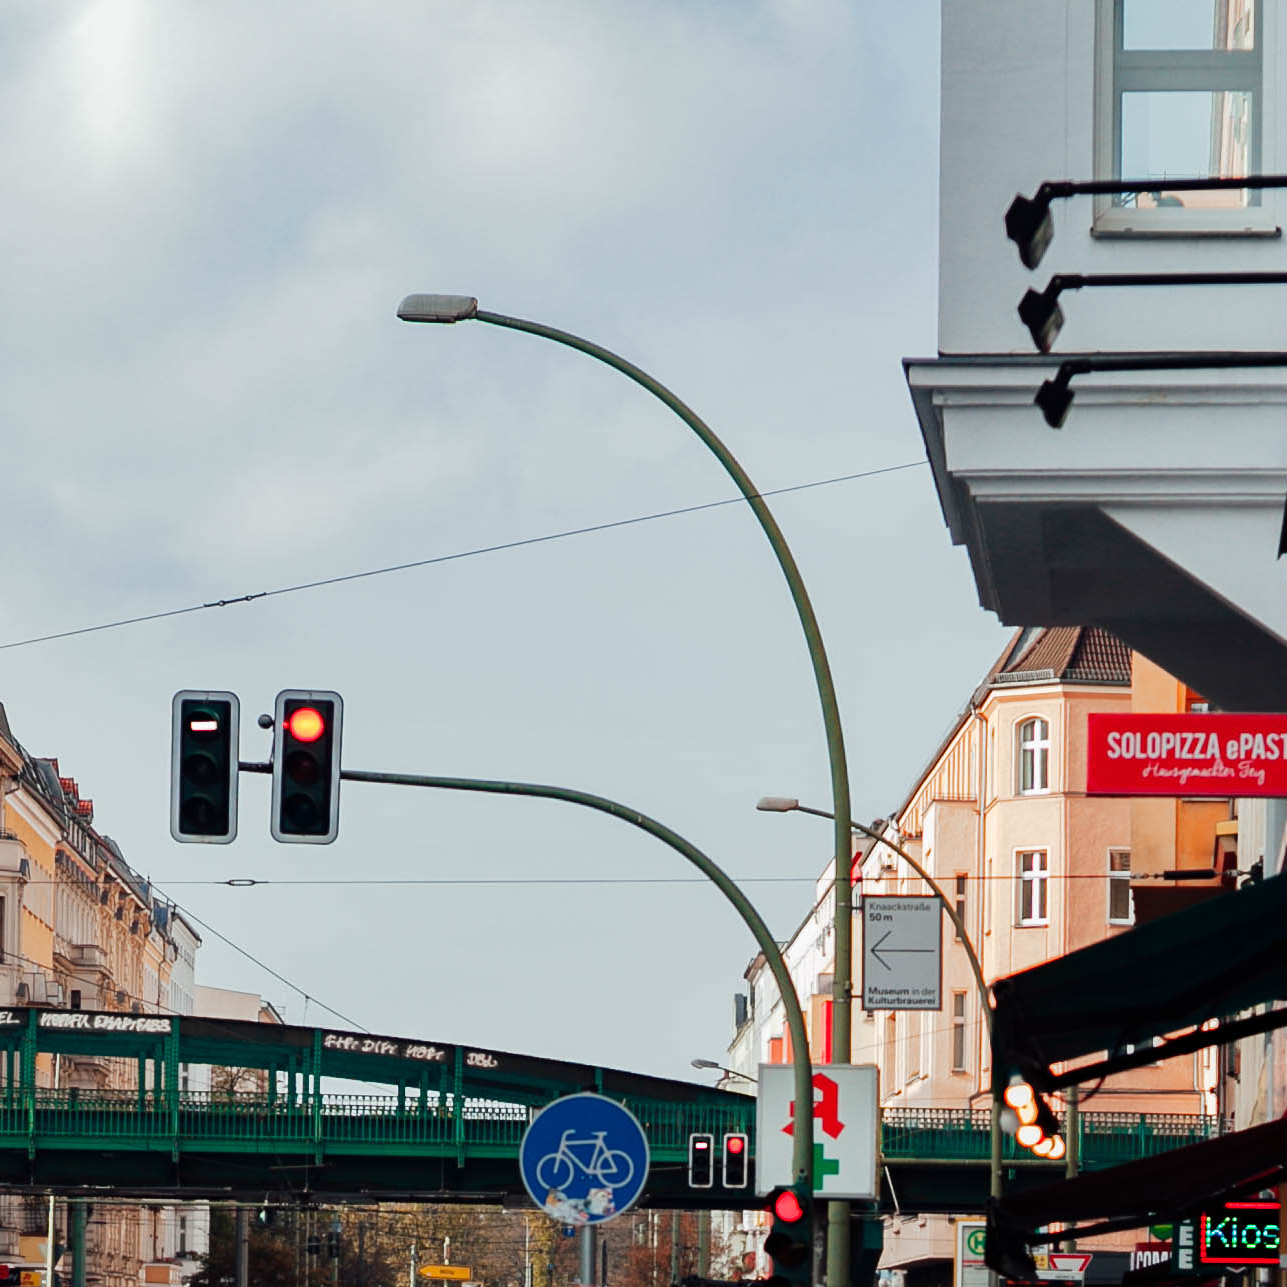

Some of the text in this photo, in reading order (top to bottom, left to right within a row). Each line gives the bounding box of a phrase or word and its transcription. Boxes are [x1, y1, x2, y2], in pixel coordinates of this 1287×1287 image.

[1106, 731, 1220, 760] SOLOPIZZA
[869, 902, 931, 912] Knaackstraße
[869, 913, 882, 922] 50
[868, 987, 936, 995] Museum in der
[868, 997, 936, 1005] Kulturbrauerei
